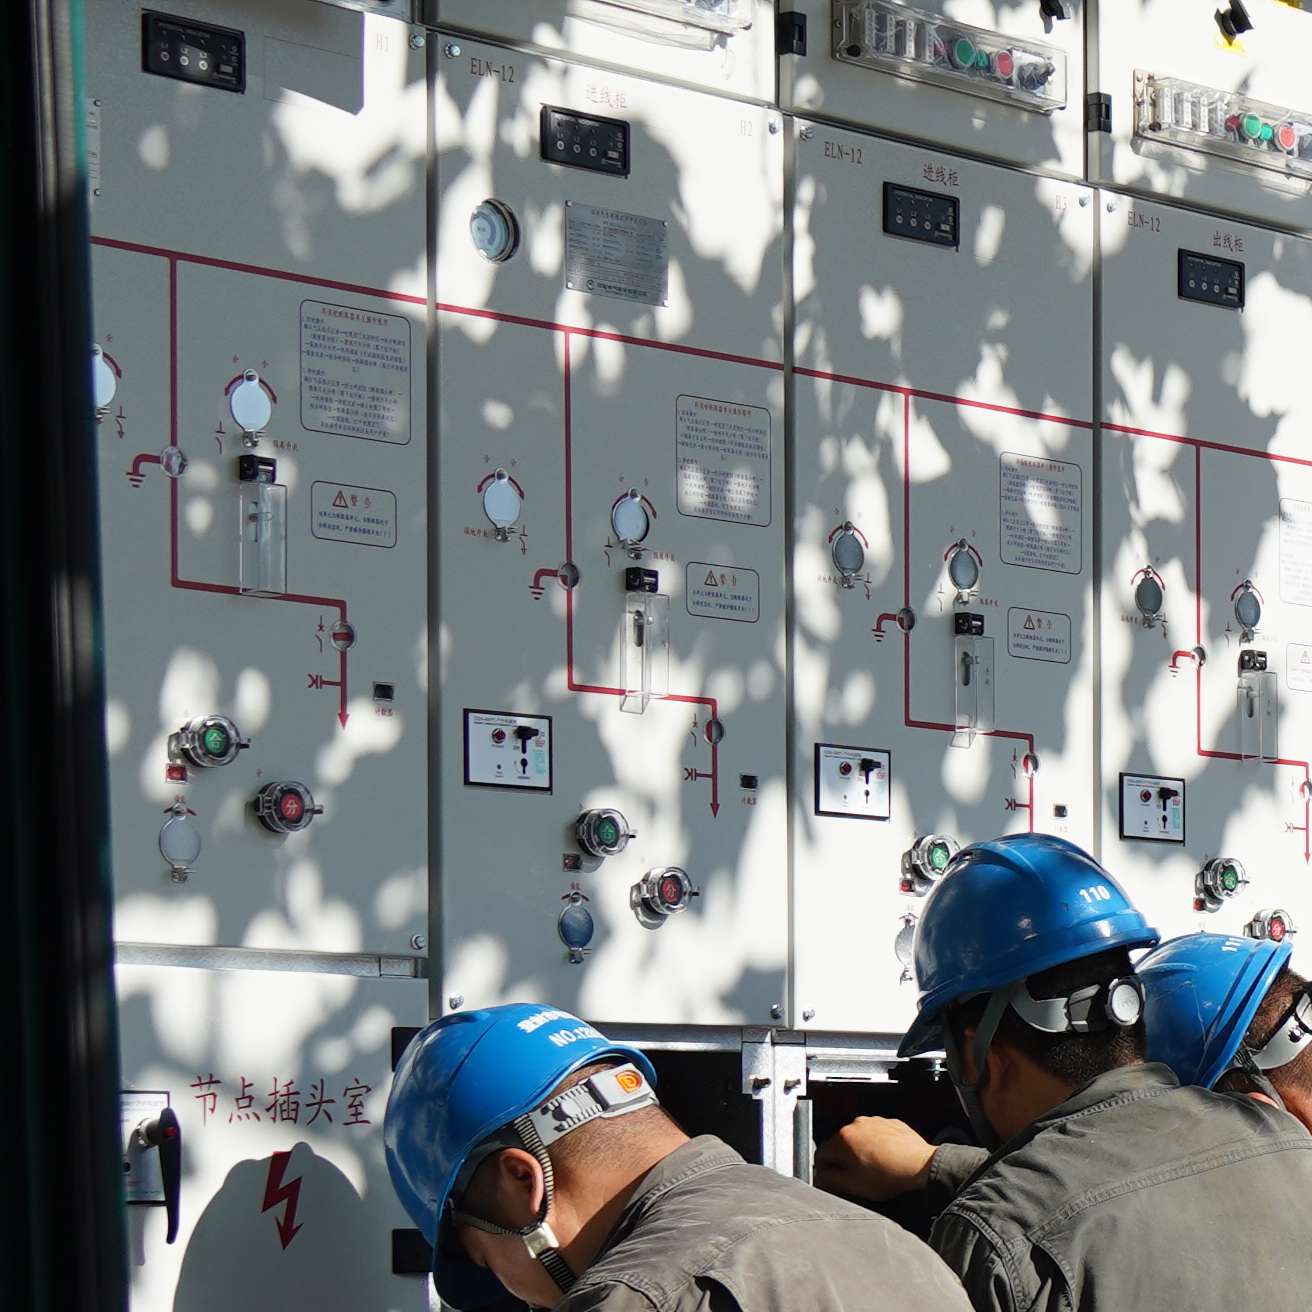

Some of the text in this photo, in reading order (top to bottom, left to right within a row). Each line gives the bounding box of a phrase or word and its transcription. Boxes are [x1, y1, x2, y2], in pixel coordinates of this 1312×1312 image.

[376, 33, 390, 52] H1
[470, 57, 516, 83] ELN-12
[585, 83, 628, 108] 进线柜
[740, 118, 753, 137] H2
[824, 141, 864, 165] ELN-12
[922, 162, 960, 188] 进线柜
[1055, 194, 1067, 211] H3
[1127, 210, 1161, 234] ELN-12
[1212, 230, 1245, 254] 出线柜
[209, 732, 223, 749] 合
[285, 798, 299, 816] 分
[601, 824, 614, 840] 合
[664, 883, 677, 897] 分
[1079, 884, 1111, 904] 110
[1221, 937, 1245, 953] 111
[188, 1072, 373, 1127] 节点插头室
